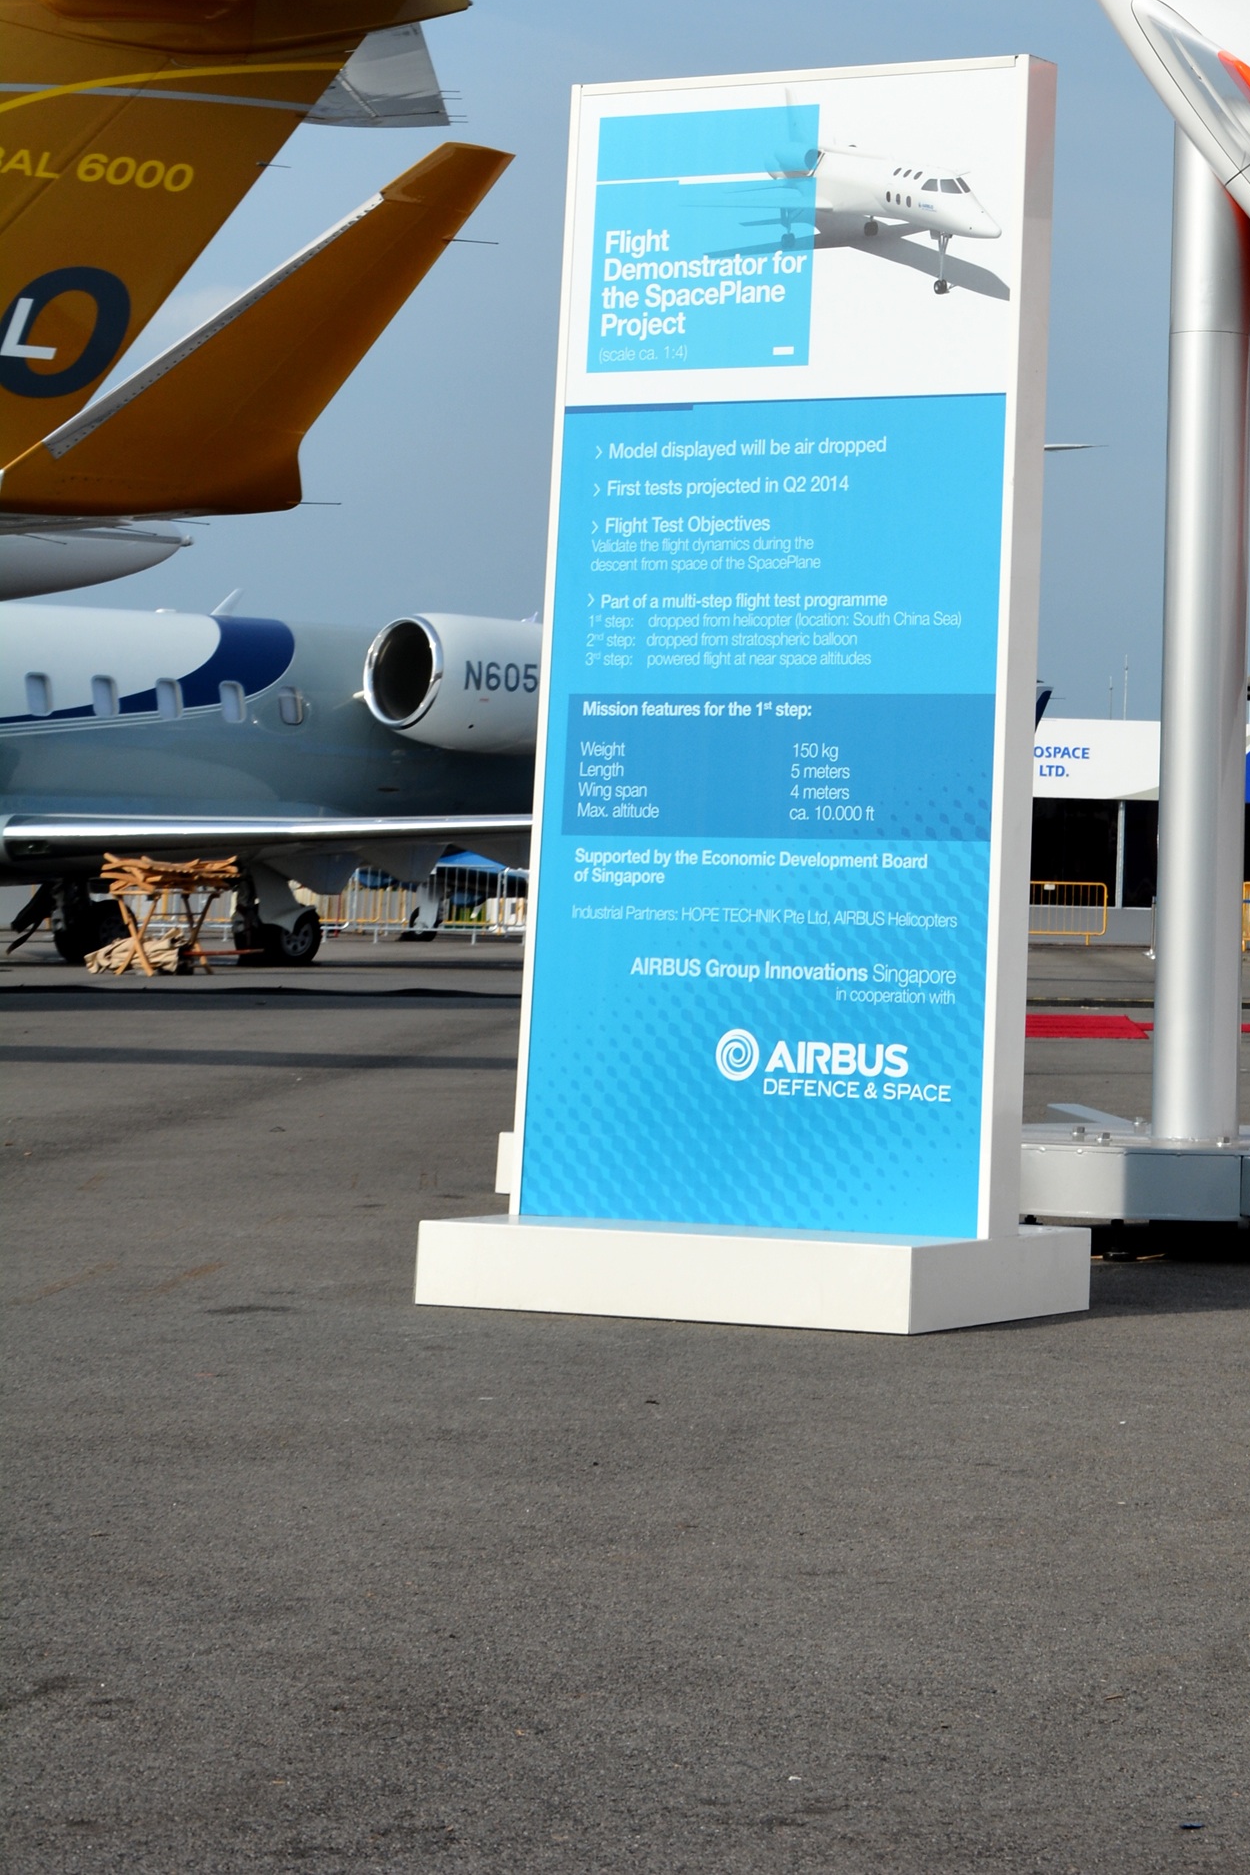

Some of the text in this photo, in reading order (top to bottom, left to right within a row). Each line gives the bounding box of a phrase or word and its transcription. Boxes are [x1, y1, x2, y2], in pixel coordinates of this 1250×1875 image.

[0, 146, 195, 193] AL 6000
[605, 229, 670, 259] Flight
[604, 250, 807, 282] Demonstrator for
[601, 280, 786, 312] the SpacePlane
[601, 312, 686, 341] Project
[599, 345, 688, 364] (scale ca. 1:4)
[609, 436, 887, 461] Model displayed will be air dropped
[607, 475, 849, 498] First tests projected in Q2 2014
[605, 515, 771, 537] Flight Test Objectives
[591, 536, 814, 555] Validate the flight dynamics during the
[590, 554, 821, 573] descent from space of the SpacePlane
[601, 592, 888, 612] Part of a multi-step flight test programme
[604, 615, 634, 631] step:
[648, 614, 700, 630] dropped
[702, 613, 730, 627] from
[733, 613, 792, 630] helicopter
[795, 612, 849, 629] (location:
[853, 611, 890, 626] South
[893, 611, 930, 626] China
[933, 611, 962, 628] Sea)
[606, 633, 636, 650] step:
[646, 632, 698, 649] dropped
[701, 632, 728, 646] from
[731, 632, 810, 649] stratospheric
[813, 631, 858, 646] balloon
[603, 653, 633, 668] step:
[647, 651, 700, 668] powered
[703, 651, 731, 669] flight
[734, 652, 746, 665] at
[749, 654, 777, 665] near
[779, 654, 817, 668] space
[820, 651, 872, 665] altitudes
[464, 660, 538, 693] N605
[583, 701, 638, 716] Mission
[641, 701, 701, 716] features
[704, 701, 725, 716] for
[728, 701, 752, 716] the
[775, 702, 812, 720] step:
[580, 741, 625, 761] Weight
[793, 743, 839, 762] 150 kg
[579, 761, 624, 781] Length
[791, 763, 850, 779] 5 meters
[1039, 765, 1070, 777] LTD.
[578, 782, 647, 801] Wing span
[790, 784, 850, 800] 4 meters
[577, 802, 660, 818] Max. altitude
[789, 805, 875, 821] ca. 10.000 ft
[575, 847, 928, 871] Supported by the Economic Development Board
[574, 867, 665, 886] of Singapore
[572, 904, 958, 930] Industrial Partners: HOPE TECHNIK Pte Ltd, AIRBUS Helicopters
[630, 957, 957, 988] AIRBUS Group Innovations Singapore
[836, 986, 956, 1005] in cooperation with
[765, 1040, 909, 1078] AIRBUS
[763, 1078, 951, 1102] DEFENCE & SPACE
